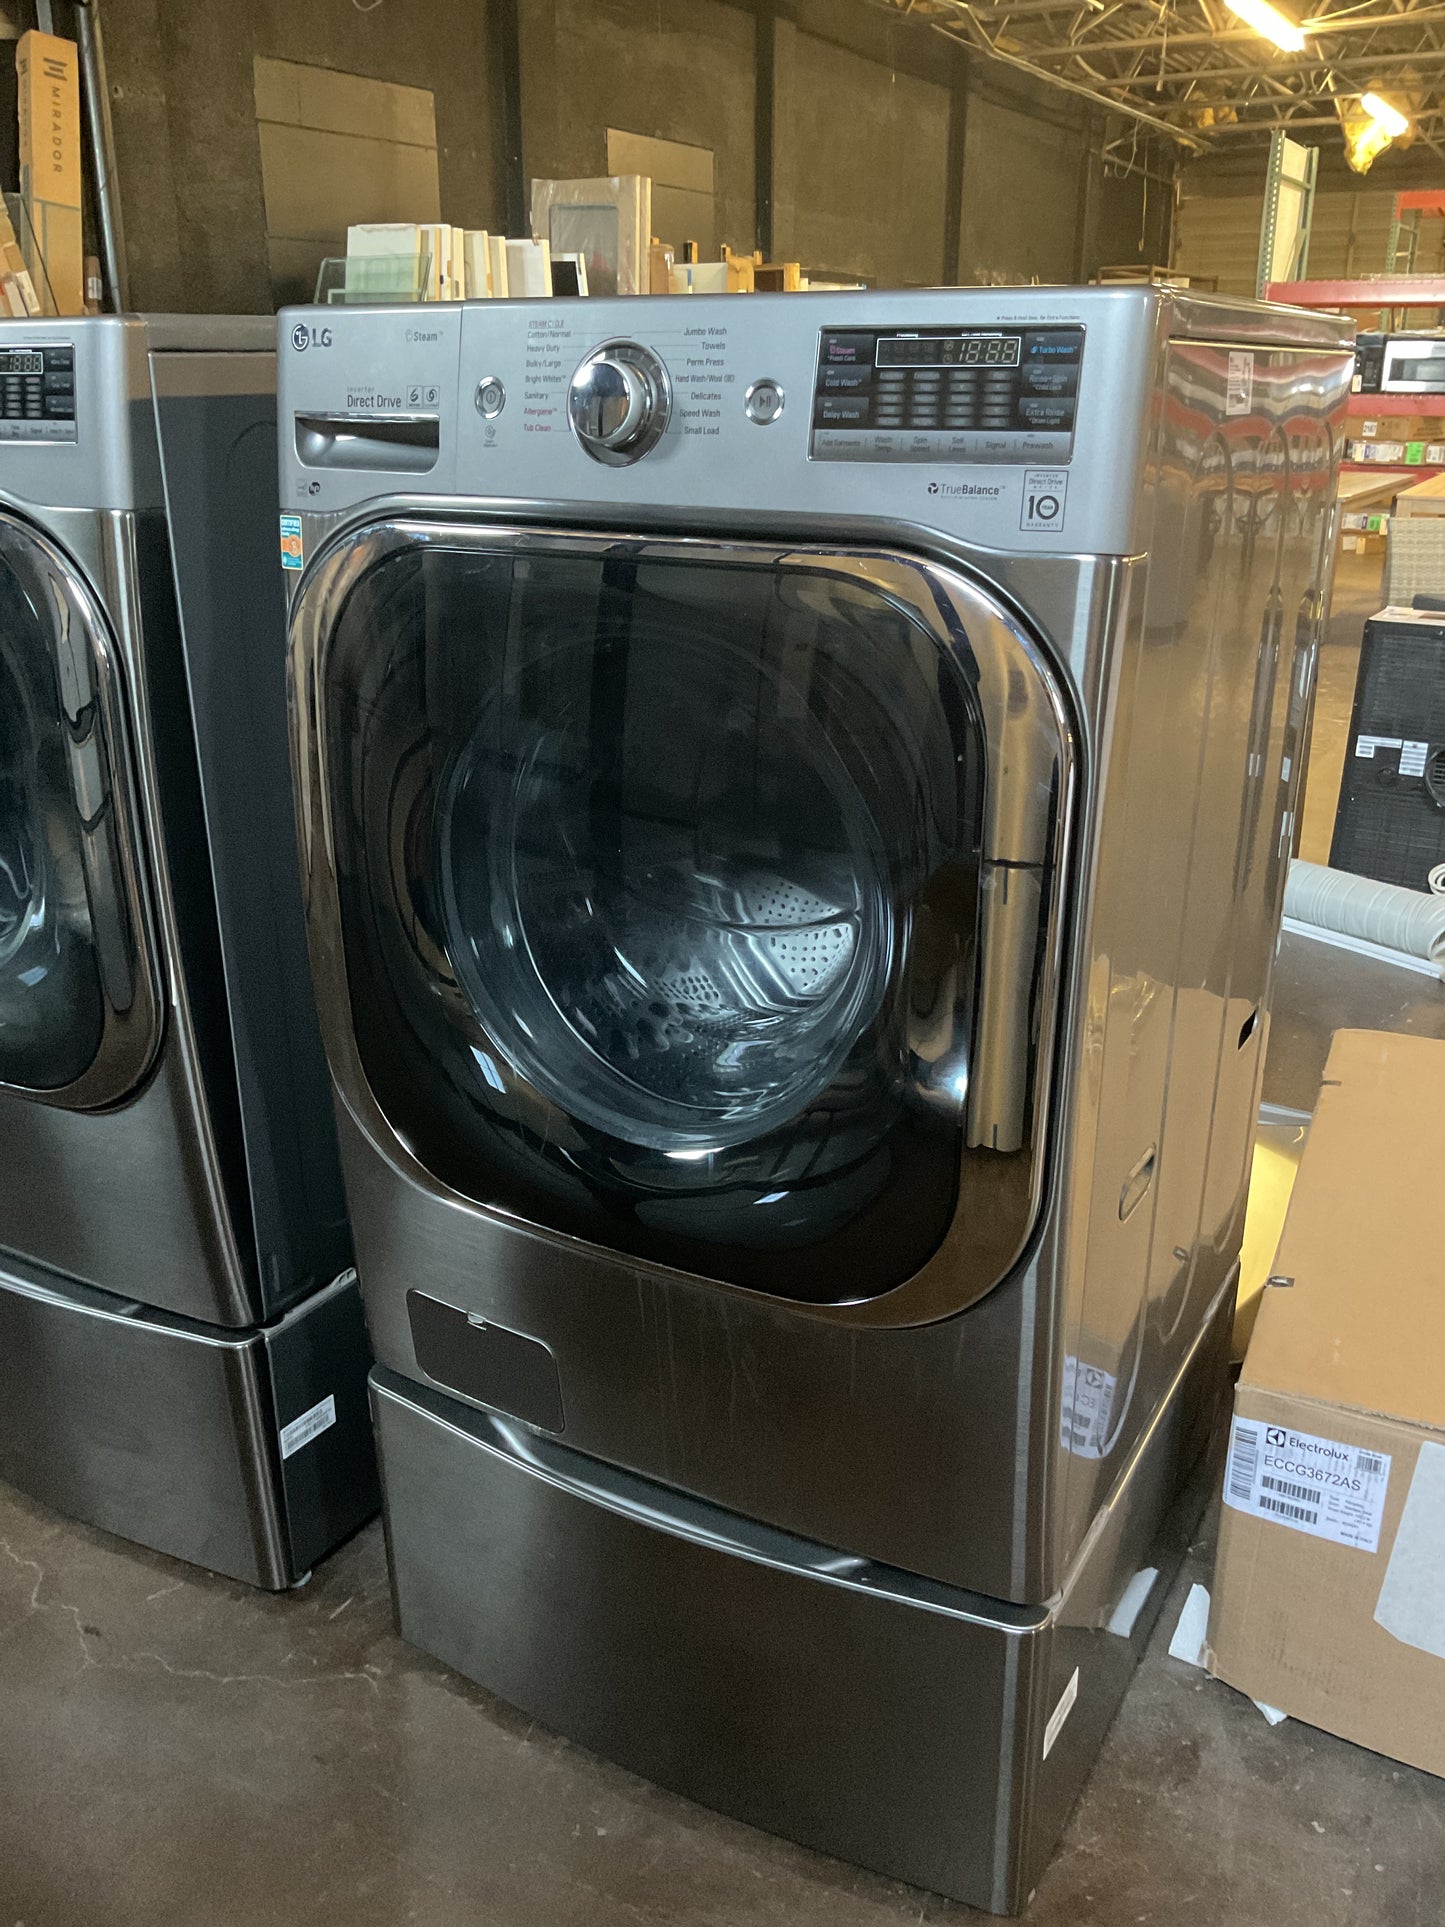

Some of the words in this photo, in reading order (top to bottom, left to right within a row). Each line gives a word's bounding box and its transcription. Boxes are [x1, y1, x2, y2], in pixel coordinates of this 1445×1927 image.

[51, 86, 62, 173] MIRADOR
[684, 328, 706, 336] Jumbo
[312, 328, 332, 348] LG
[702, 342, 726, 350] Towels
[526, 360, 561, 368] Bulky/Large
[525, 376, 542, 384] Bright
[690, 392, 722, 400] Delicates
[347, 394, 374, 408] Direct
[376, 394, 402, 408] Drive
[680, 409, 700, 418] Speed
[701, 409, 720, 417] Wash
[823, 412, 840, 420] Delay
[684, 426, 702, 434] Small
[703, 426, 720, 434] Load
[986, 441, 1006, 450] Signal
[1023, 441, 1054, 449] Prewash
[1028, 495, 1060, 520] 10
[1289, 1437, 1349, 1462] Electrolux
[1264, 1455, 1361, 1492] ECCG3672AS
